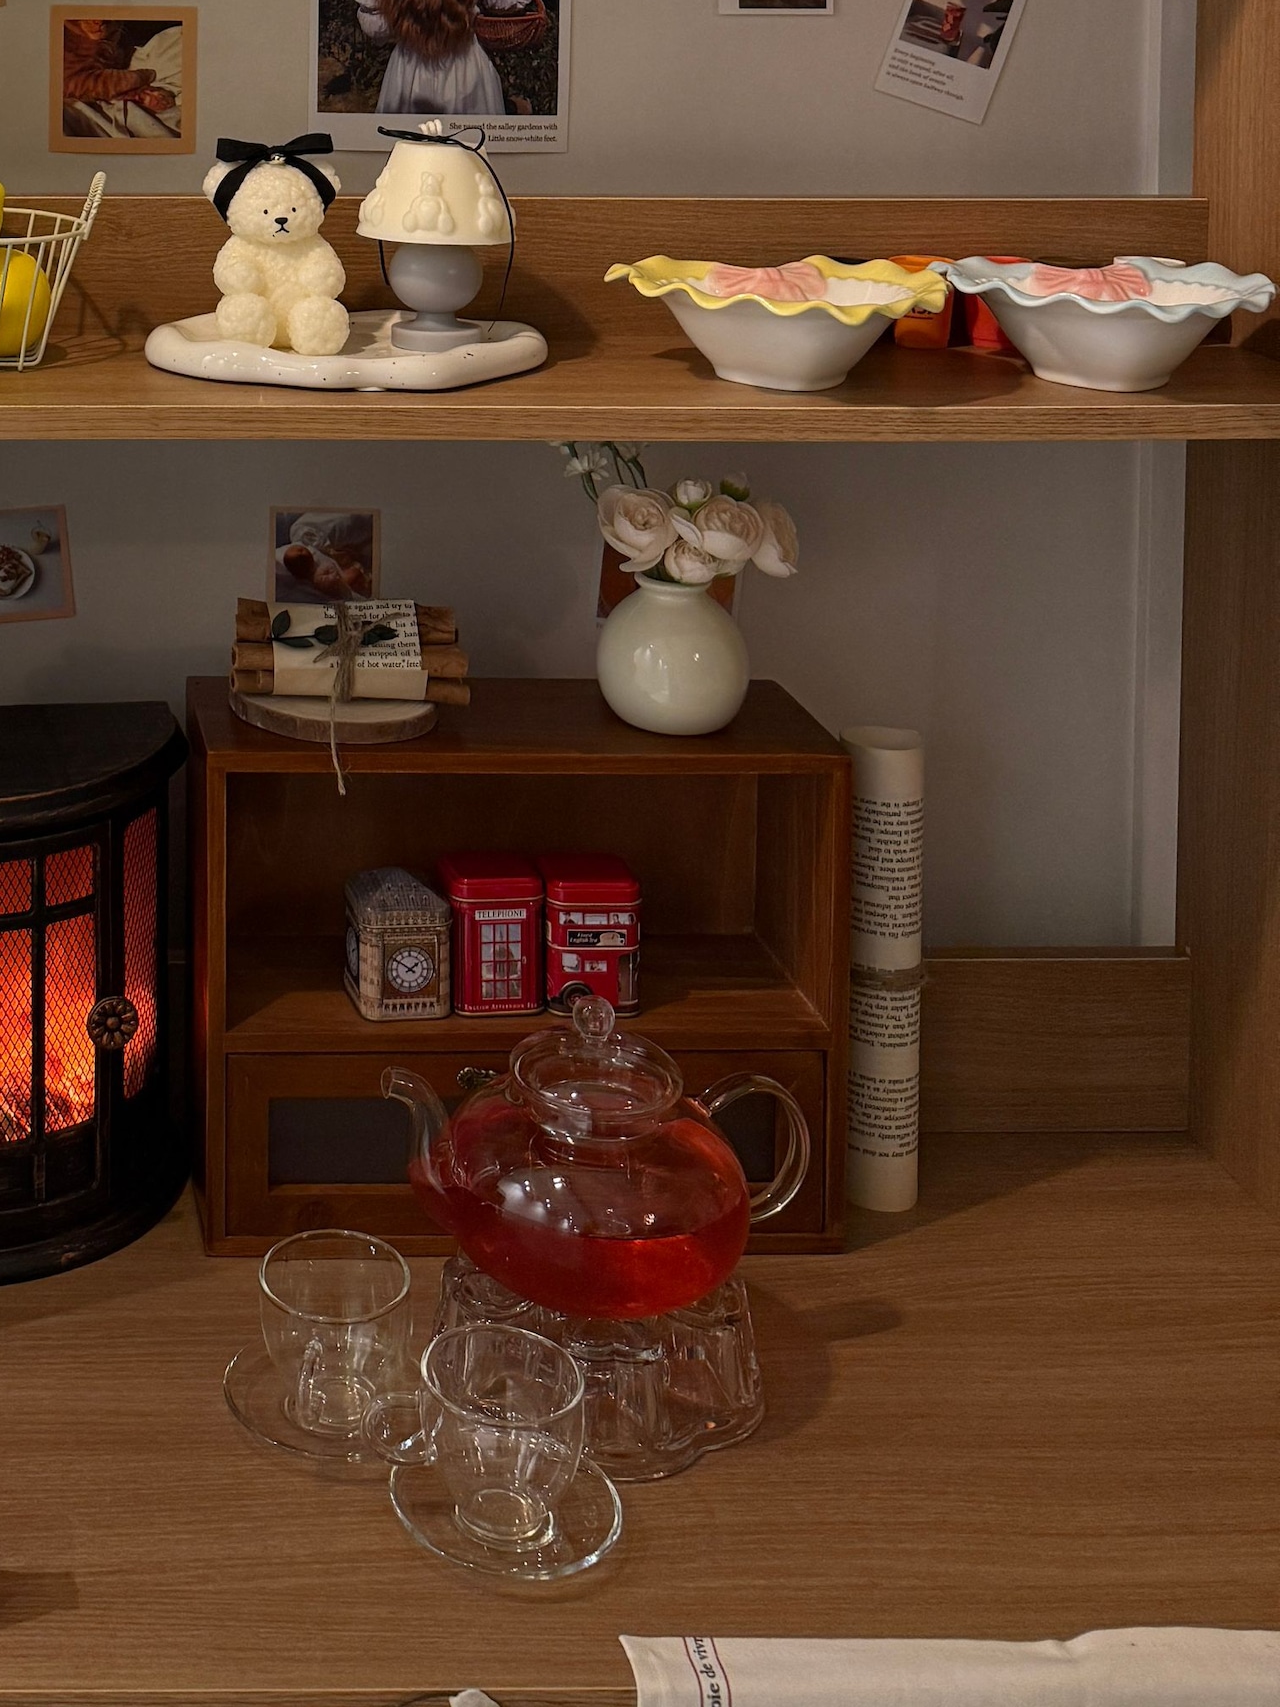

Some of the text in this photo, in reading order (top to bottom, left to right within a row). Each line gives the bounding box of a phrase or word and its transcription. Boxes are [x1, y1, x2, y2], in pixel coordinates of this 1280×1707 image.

[498, 122, 516, 131] salley
[517, 122, 542, 131] gardens
[357, 660, 365, 668] of
[367, 660, 379, 668] hot
[477, 910, 524, 918] TELEPHONE
[693, 1636, 722, 1707] oie de vivr
